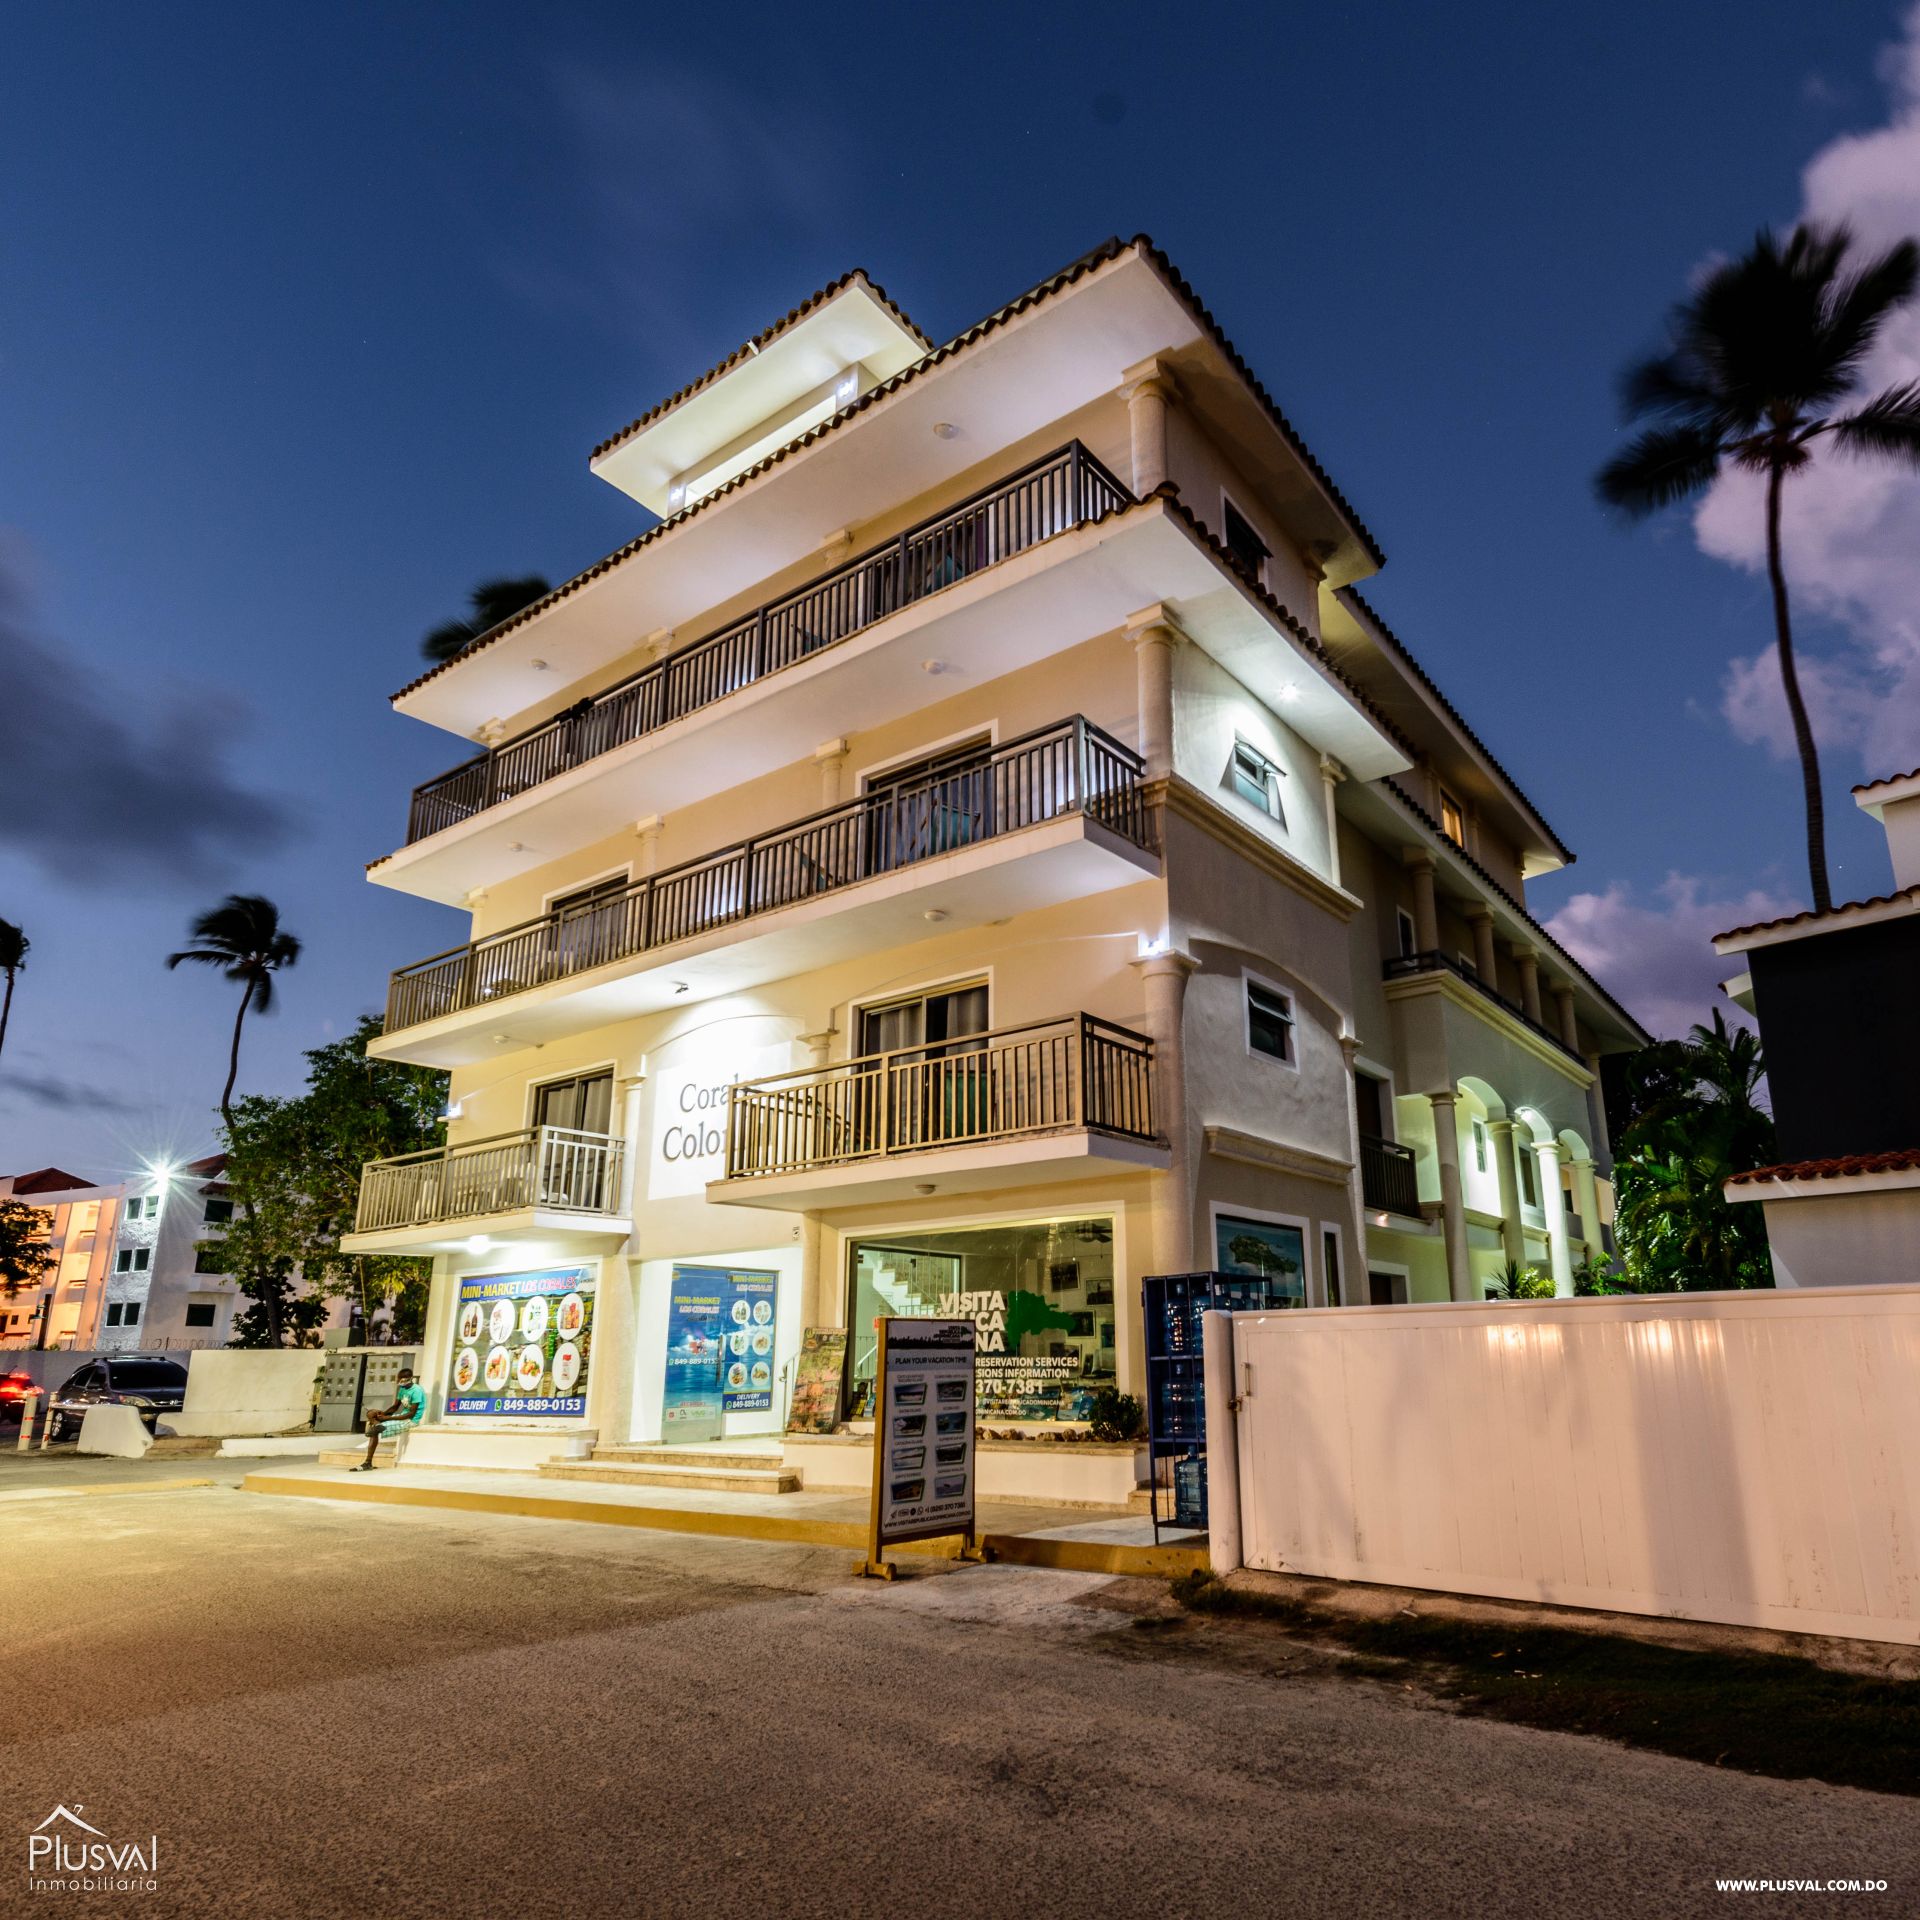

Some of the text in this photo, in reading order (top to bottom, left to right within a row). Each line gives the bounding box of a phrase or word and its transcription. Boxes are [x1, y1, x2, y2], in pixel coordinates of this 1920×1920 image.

[663, 1121, 728, 1163] Colo
[461, 1281, 520, 1299] MINI-MARKET
[674, 1296, 720, 1304] MINI-MARKET
[939, 1290, 1006, 1313] VISITA
[928, 1356, 954, 1364] VACATION
[975, 1357, 1078, 1367] RESERVATION SERVICES
[975, 1368, 1002, 1378] SIONS
[1005, 1368, 1070, 1378] INFORMATION
[975, 1379, 1043, 1394] 370-7381
[459, 1399, 581, 1411] DELIVERY 849-889-0153
[732, 1399, 769, 1408] 849-889-0153
